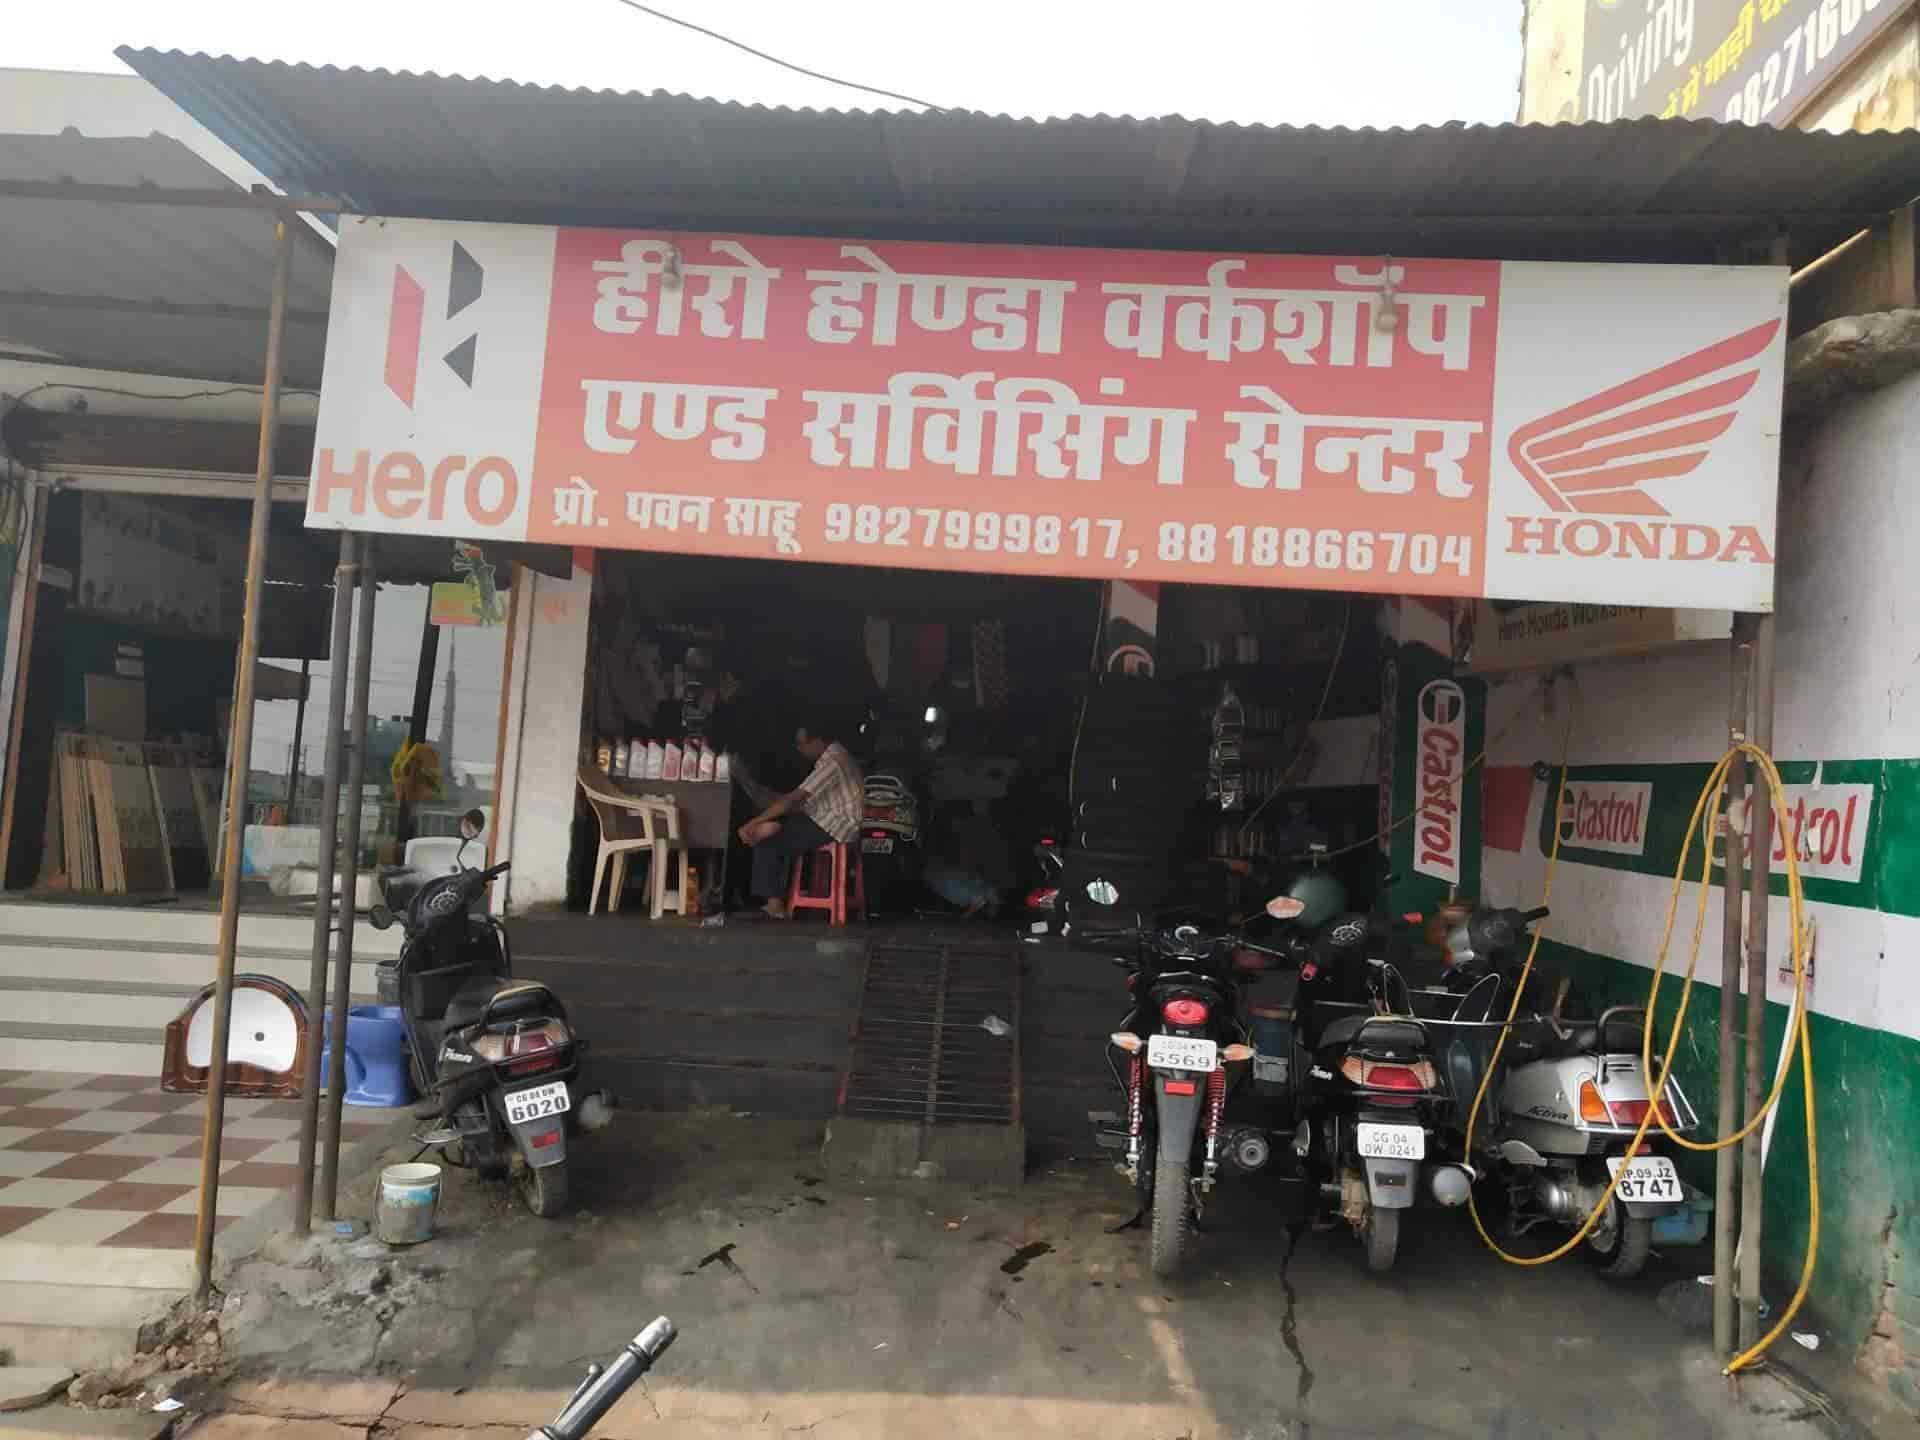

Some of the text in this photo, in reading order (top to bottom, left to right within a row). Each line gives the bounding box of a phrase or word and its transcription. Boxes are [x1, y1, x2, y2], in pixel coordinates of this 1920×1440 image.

[592, 239, 1485, 371] हीरो होण्डा वर्कशॉप
[580, 371, 1483, 498] एण्ड सर्विसिंग सेन्टर
[313, 448, 519, 527] Hero
[552, 476, 1473, 578] प्रो. पवन साहू 9827999817, 8818866704
[1505, 516, 1775, 564] HONDA
[1420, 728, 1460, 868] Castrol
[1576, 789, 1644, 843] Castrol
[1743, 794, 1857, 865] strol
[1152, 1052, 1210, 1067] 5569
[512, 1096, 567, 1121] 6020
[1620, 1179, 1675, 1197] 8747
